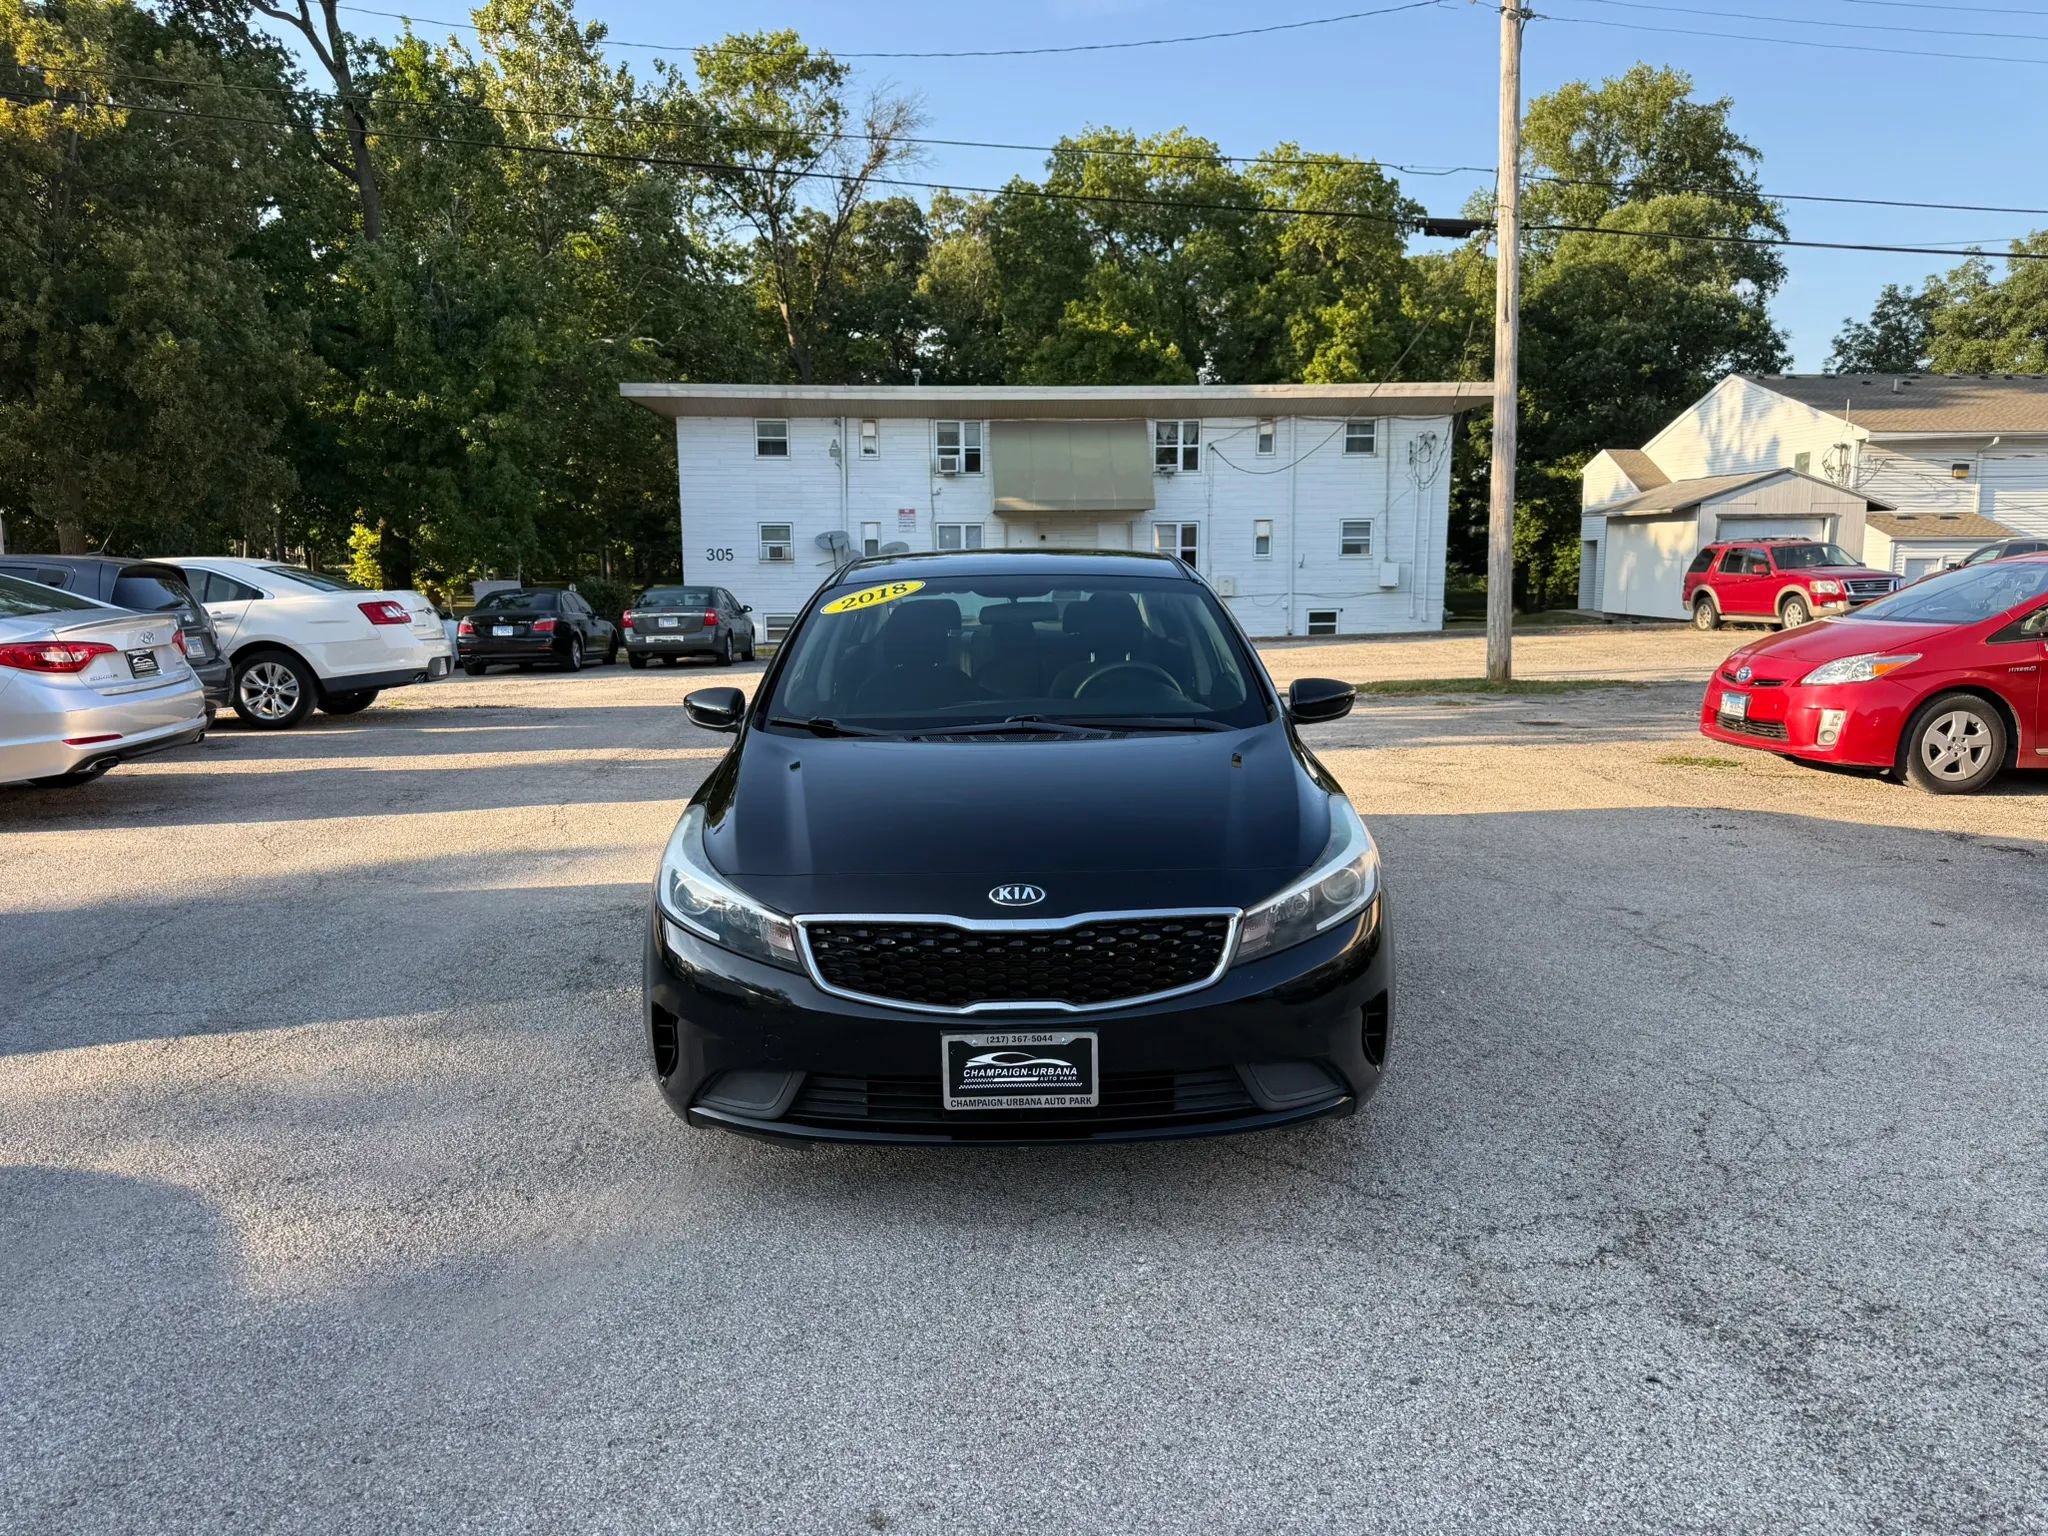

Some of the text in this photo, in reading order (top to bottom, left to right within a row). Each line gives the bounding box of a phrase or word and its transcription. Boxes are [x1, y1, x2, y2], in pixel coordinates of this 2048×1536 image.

[706, 548, 734, 561] 305
[841, 583, 908, 610] 2018
[999, 886, 1036, 900] KIA
[986, 1034, 1053, 1044] (217) 367-5044
[963, 1067, 1078, 1077] CHAMPAIGN-URBANA
[950, 1096, 1092, 1108] CHAMPAIGN-URBANA AUTO PARK
